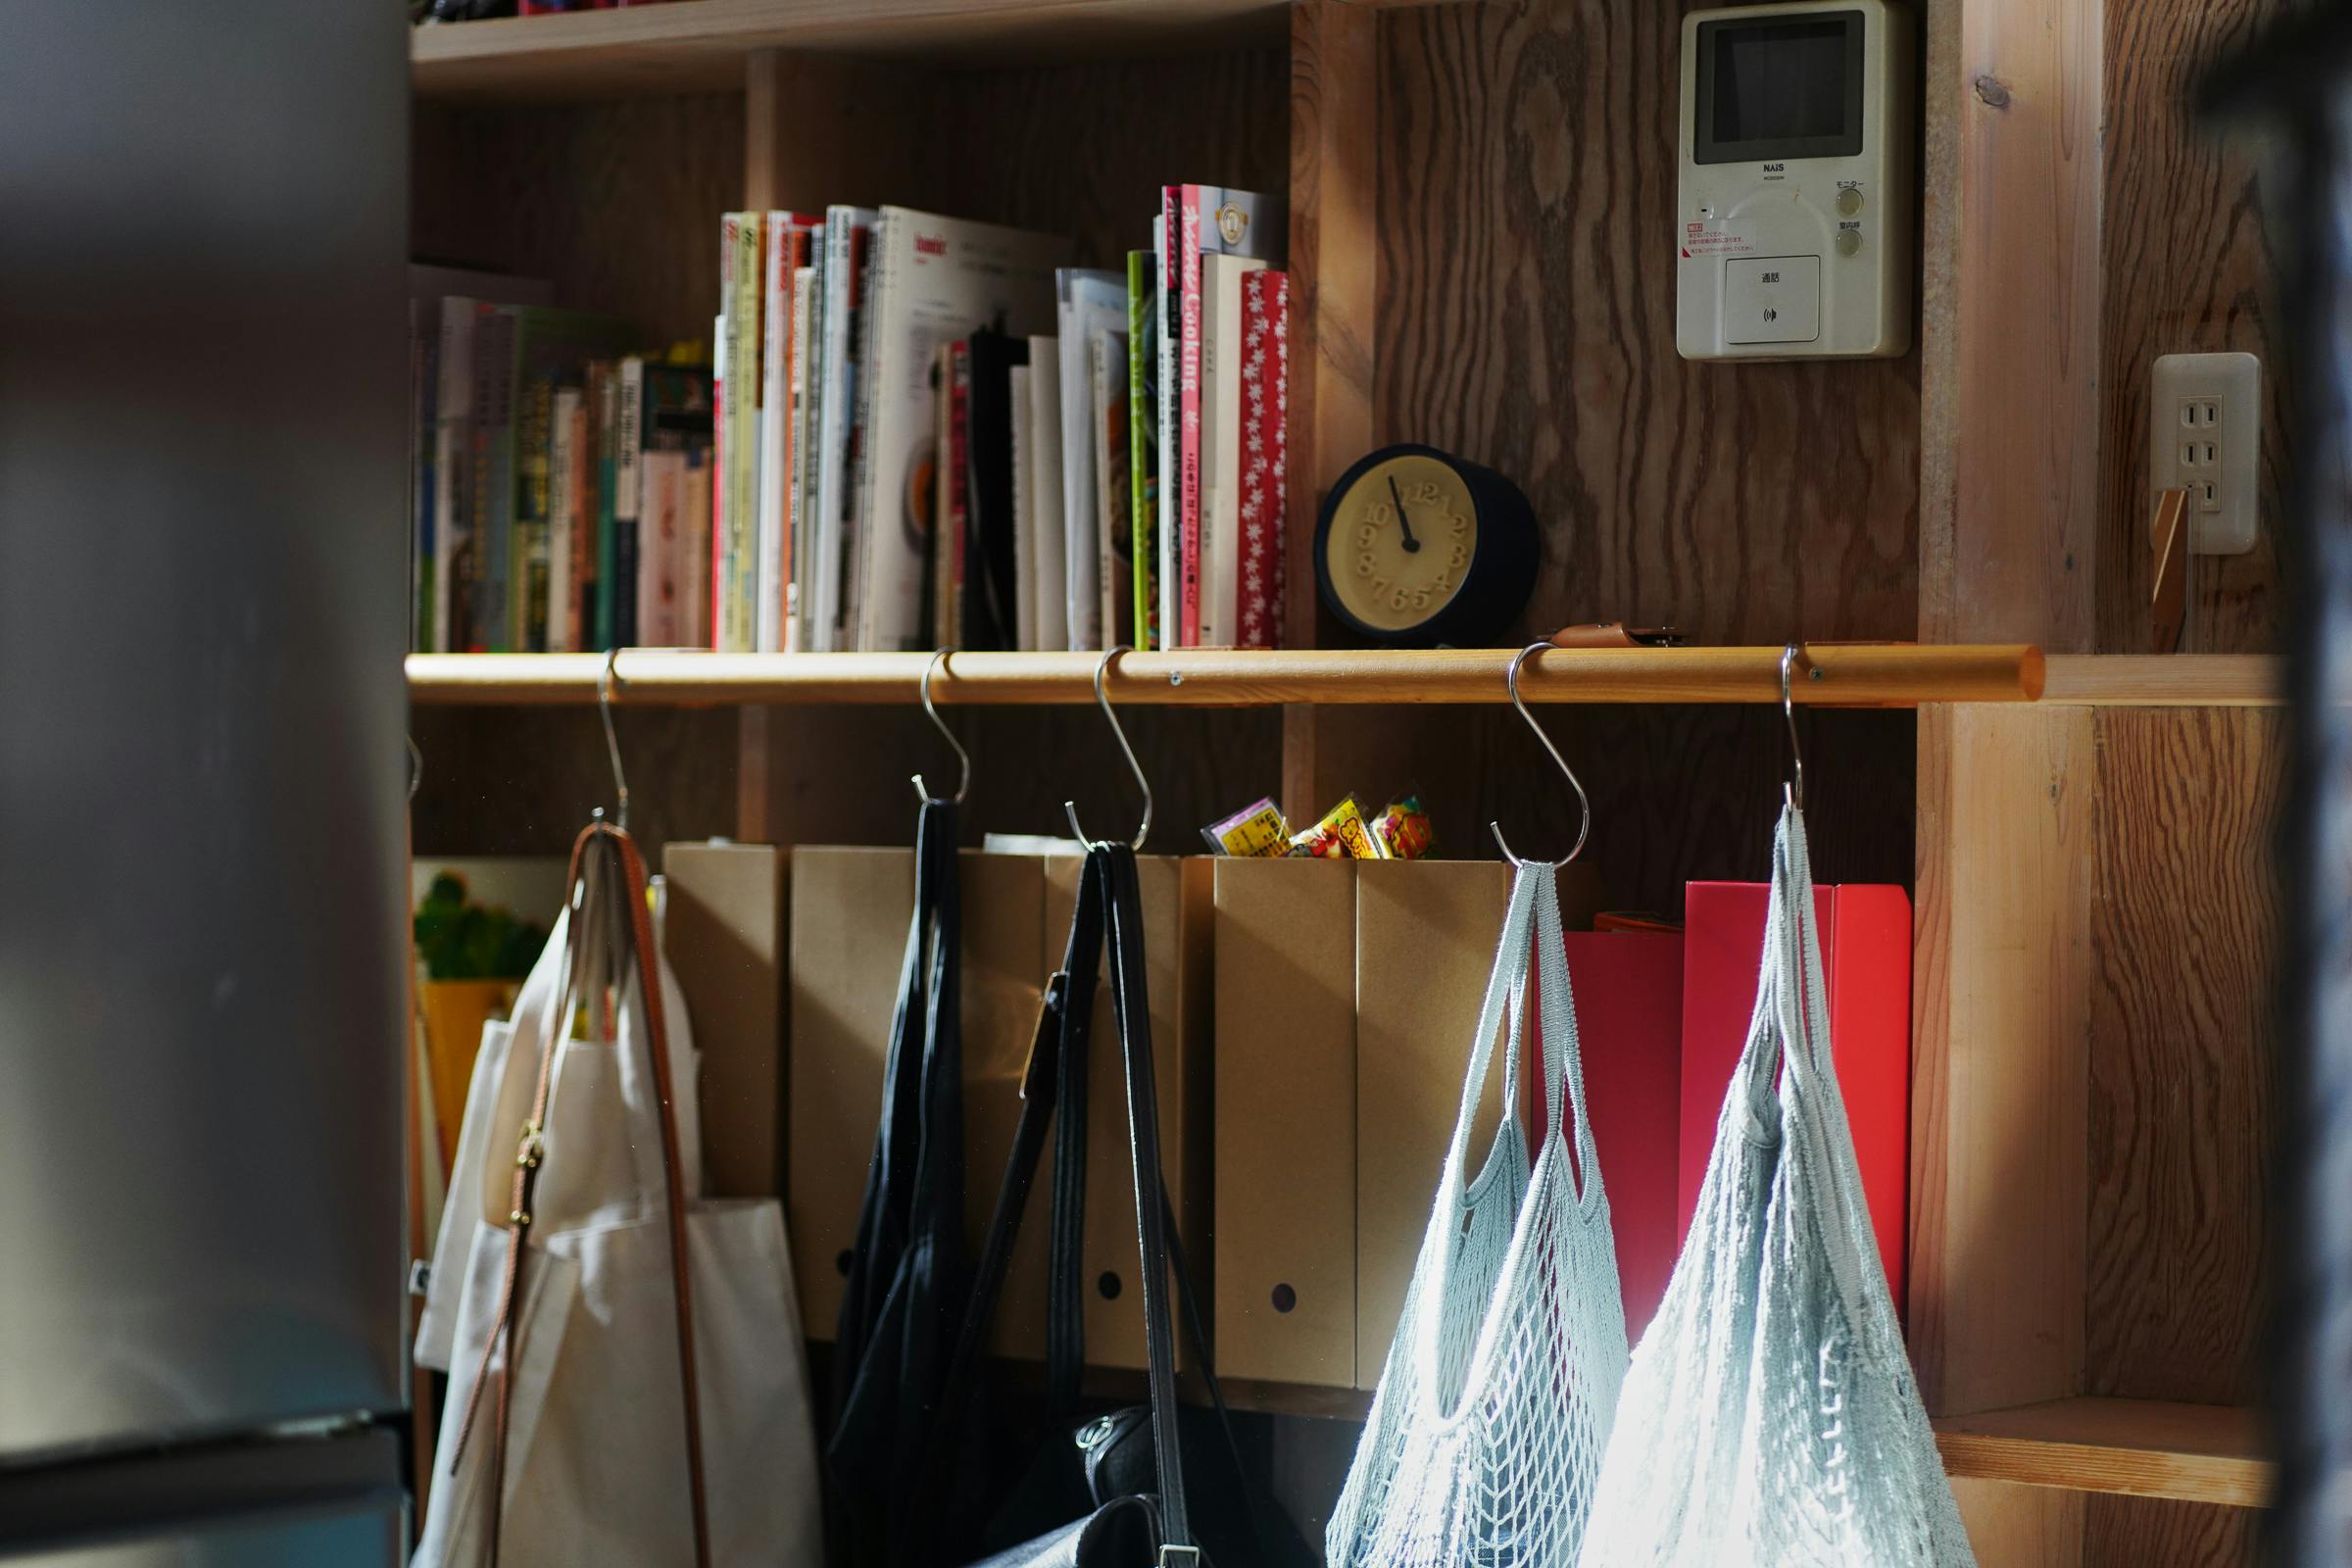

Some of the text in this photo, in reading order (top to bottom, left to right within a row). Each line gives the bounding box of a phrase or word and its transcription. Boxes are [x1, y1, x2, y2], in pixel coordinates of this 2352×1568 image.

[1761, 272, 1780, 283] 通話
[1181, 293, 1200, 391] Cooking
[1411, 482, 1439, 506] 12
[1441, 494, 1452, 517] 1
[1366, 502, 1390, 525] 10
[1358, 526, 1377, 550] 9
[1451, 514, 1468, 539] 2
[1357, 553, 1377, 576] 8
[1449, 543, 1468, 567] 3
[1373, 579, 1388, 604] 7
[1435, 569, 1451, 592] 4
[1391, 589, 1409, 611] 6
[1411, 589, 1432, 610] 5
